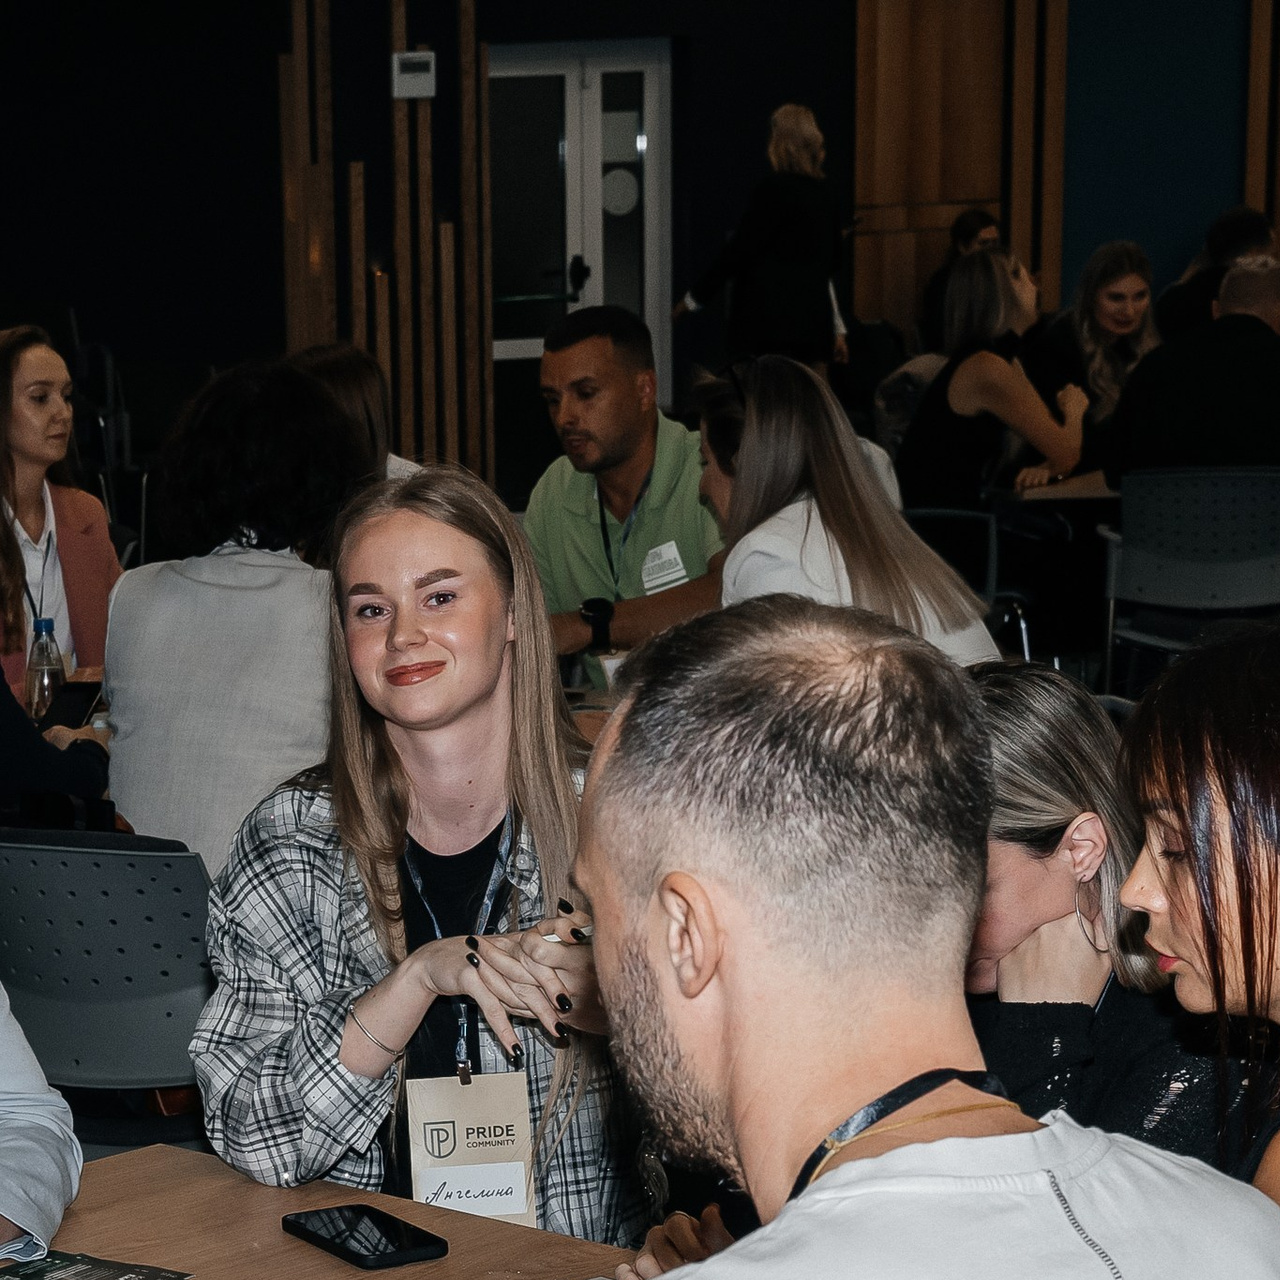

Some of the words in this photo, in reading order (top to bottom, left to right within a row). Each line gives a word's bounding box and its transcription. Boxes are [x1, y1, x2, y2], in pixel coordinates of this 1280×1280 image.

[465, 1124, 516, 1140] PRIDE
[466, 1138, 516, 1149] COMMUNITY
[424, 1181, 515, 1205] Ангелина
